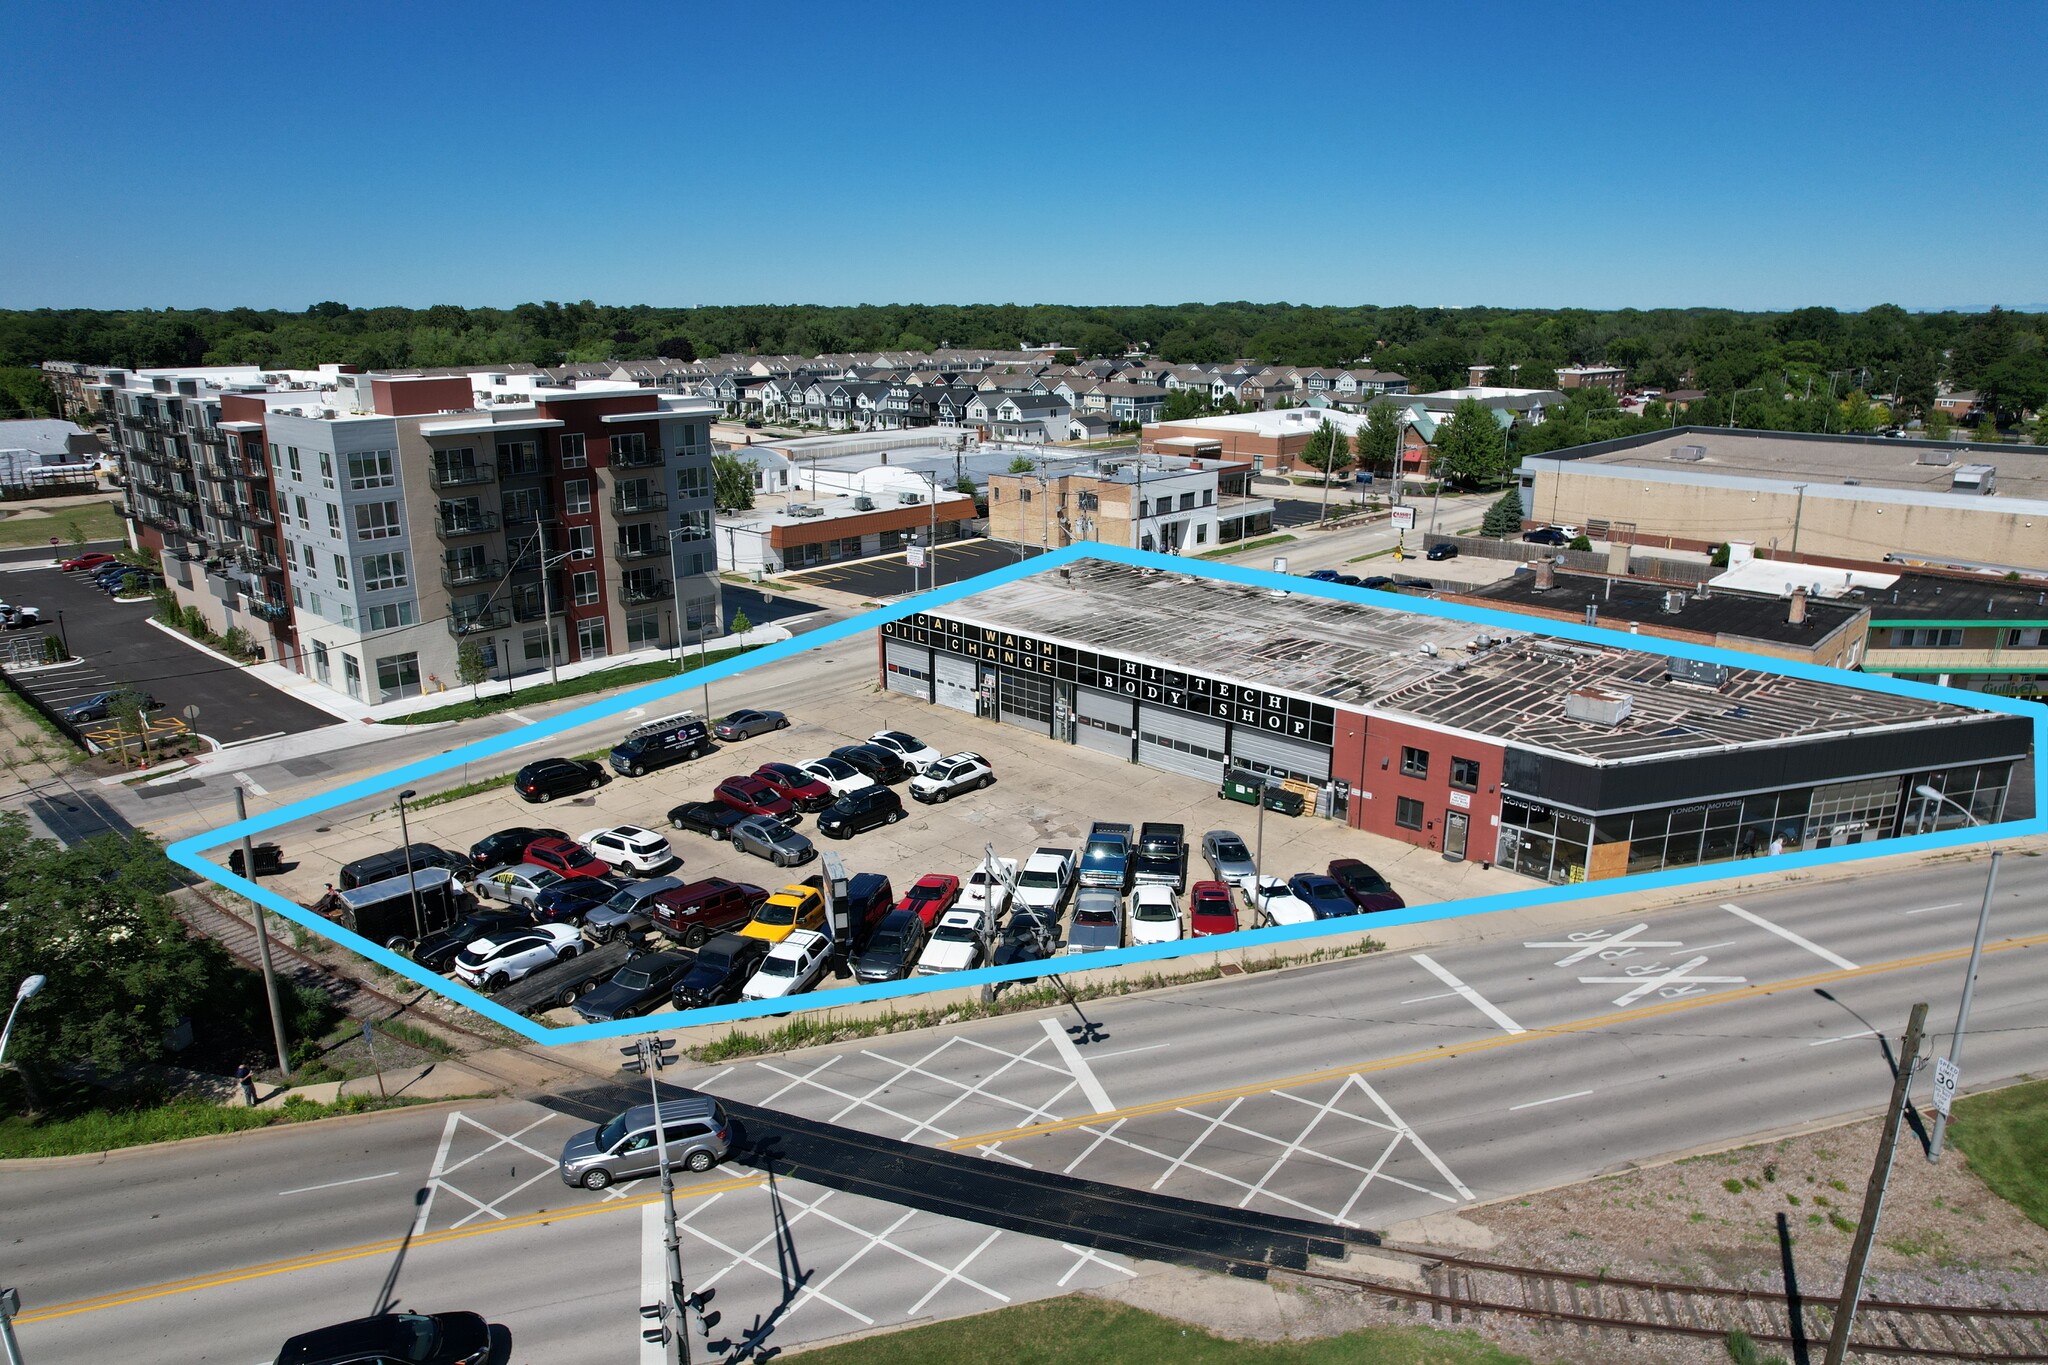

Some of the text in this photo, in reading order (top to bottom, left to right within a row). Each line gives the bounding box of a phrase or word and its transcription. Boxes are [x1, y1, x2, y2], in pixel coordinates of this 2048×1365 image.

[918, 615, 1052, 655] CAR WASH
[886, 623, 1052, 673] OIL CHANGE
[1104, 676, 1305, 734] BODY SHOP
[1503, 797, 1591, 825] LONDON MOTORS
[1671, 799, 1742, 815] LONDON MOTORS
[1939, 1060, 1958, 1075] SPEED
[1940, 1066, 1955, 1079] LIMIT
[1936, 1072, 1955, 1090] 30
